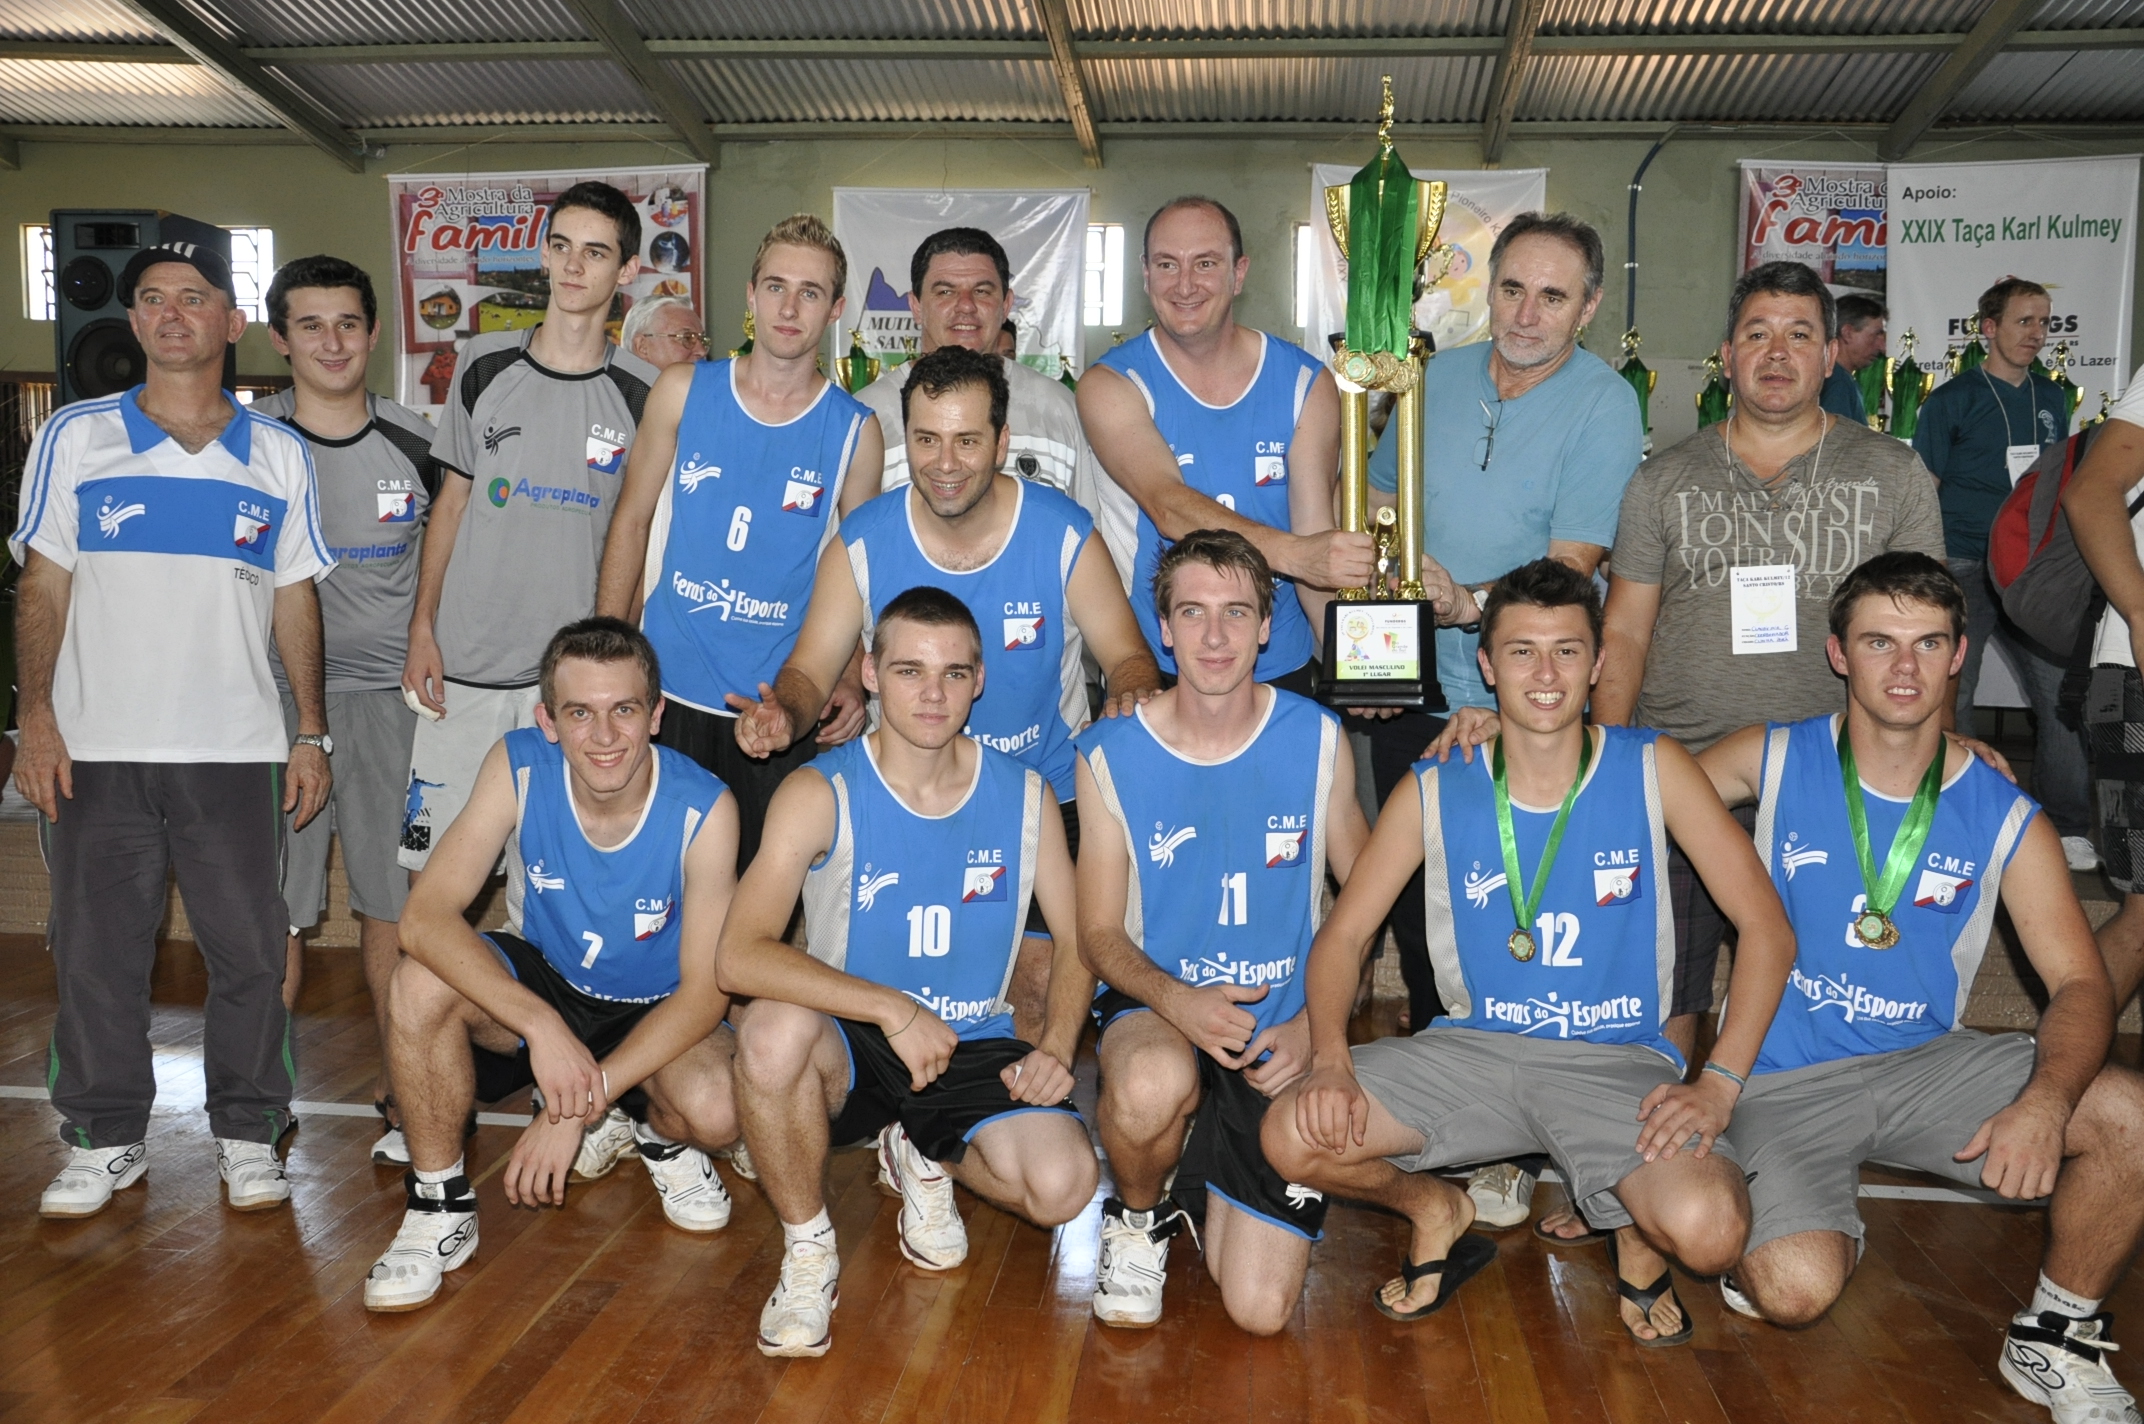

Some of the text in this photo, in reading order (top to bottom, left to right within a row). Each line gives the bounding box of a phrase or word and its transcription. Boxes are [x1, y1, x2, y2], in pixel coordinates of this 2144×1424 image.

[447, 187, 507, 203] Mostra
[511, 185, 532, 201] da
[1791, 192, 1887, 212] Agricultu
[1806, 177, 1873, 193] Mostra
[1902, 185, 1957, 203] Apoio:
[434, 201, 534, 220] Agricultura
[1450, 190, 1493, 225] Pioneiro
[1900, 213, 2122, 248] XXIX Taça Karl Kulmey
[874, 335, 921, 350] SANT
[726, 505, 753, 552] 6
[672, 570, 789, 619] Feras do Esporte
[1217, 872, 1248, 926] 11
[906, 904, 951, 958] 10
[1535, 912, 1583, 967] 12
[580, 930, 604, 970] 7
[1202, 965, 1216, 978] do
[1239, 955, 1297, 987] Esporte
[1485, 994, 1643, 1027] Feras do Esporte
[1825, 985, 1839, 1000] do
[1853, 985, 1928, 1021] Esporte
